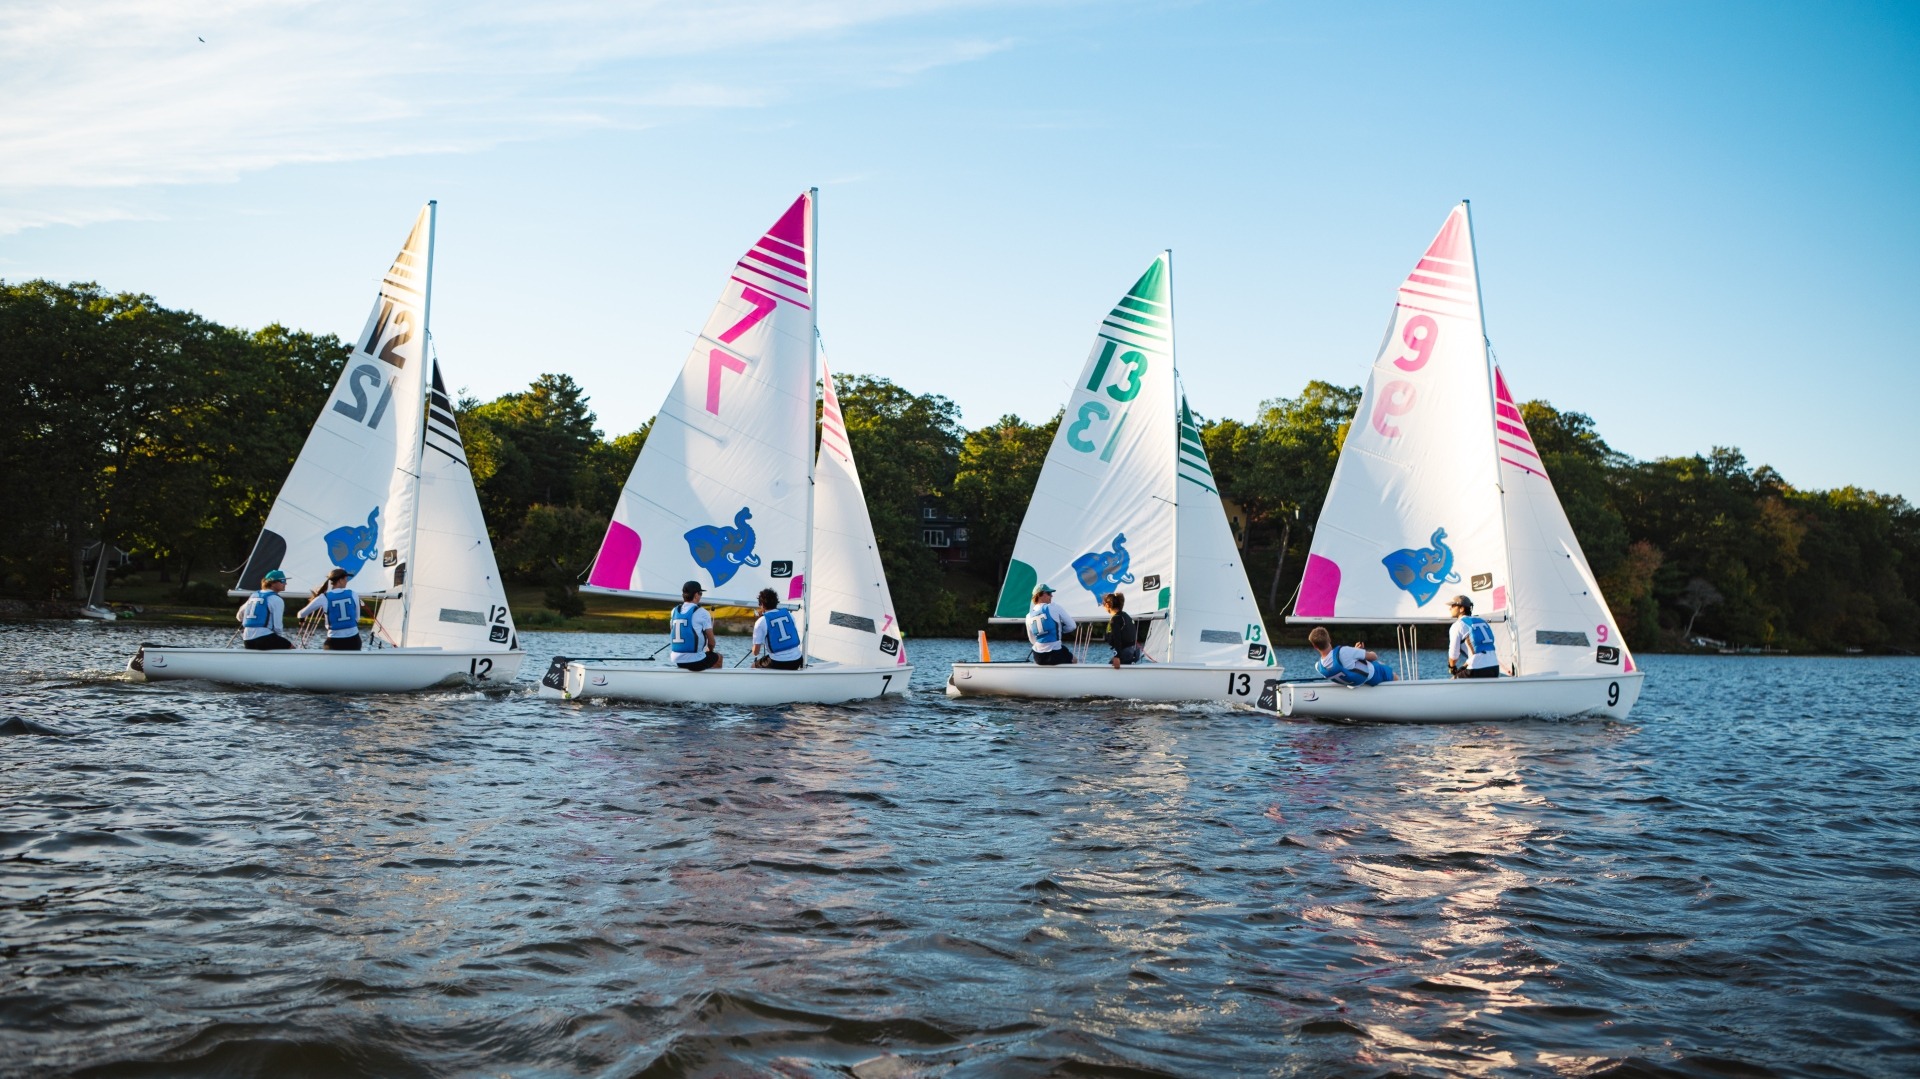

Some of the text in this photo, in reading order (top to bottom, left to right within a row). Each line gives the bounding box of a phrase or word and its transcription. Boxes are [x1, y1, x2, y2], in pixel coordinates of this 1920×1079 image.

[718, 286, 777, 344] 7
[364, 300, 416, 370] 12
[1393, 314, 1439, 372] 9
[1086, 340, 1148, 403] 13
[247, 597, 265, 619] T
[331, 597, 352, 622] T
[488, 604, 507, 625] 12
[672, 619, 688, 644] T
[770, 615, 792, 643] T
[881, 613, 894, 632] 7
[1031, 613, 1048, 636] T
[1245, 623, 1262, 642] 13
[1472, 622, 1493, 644] T
[1596, 624, 1609, 643] 9
[470, 657, 493, 680] 12
[881, 674, 893, 696] 7
[1227, 672, 1251, 697] 13
[1607, 681, 1620, 708] 9
